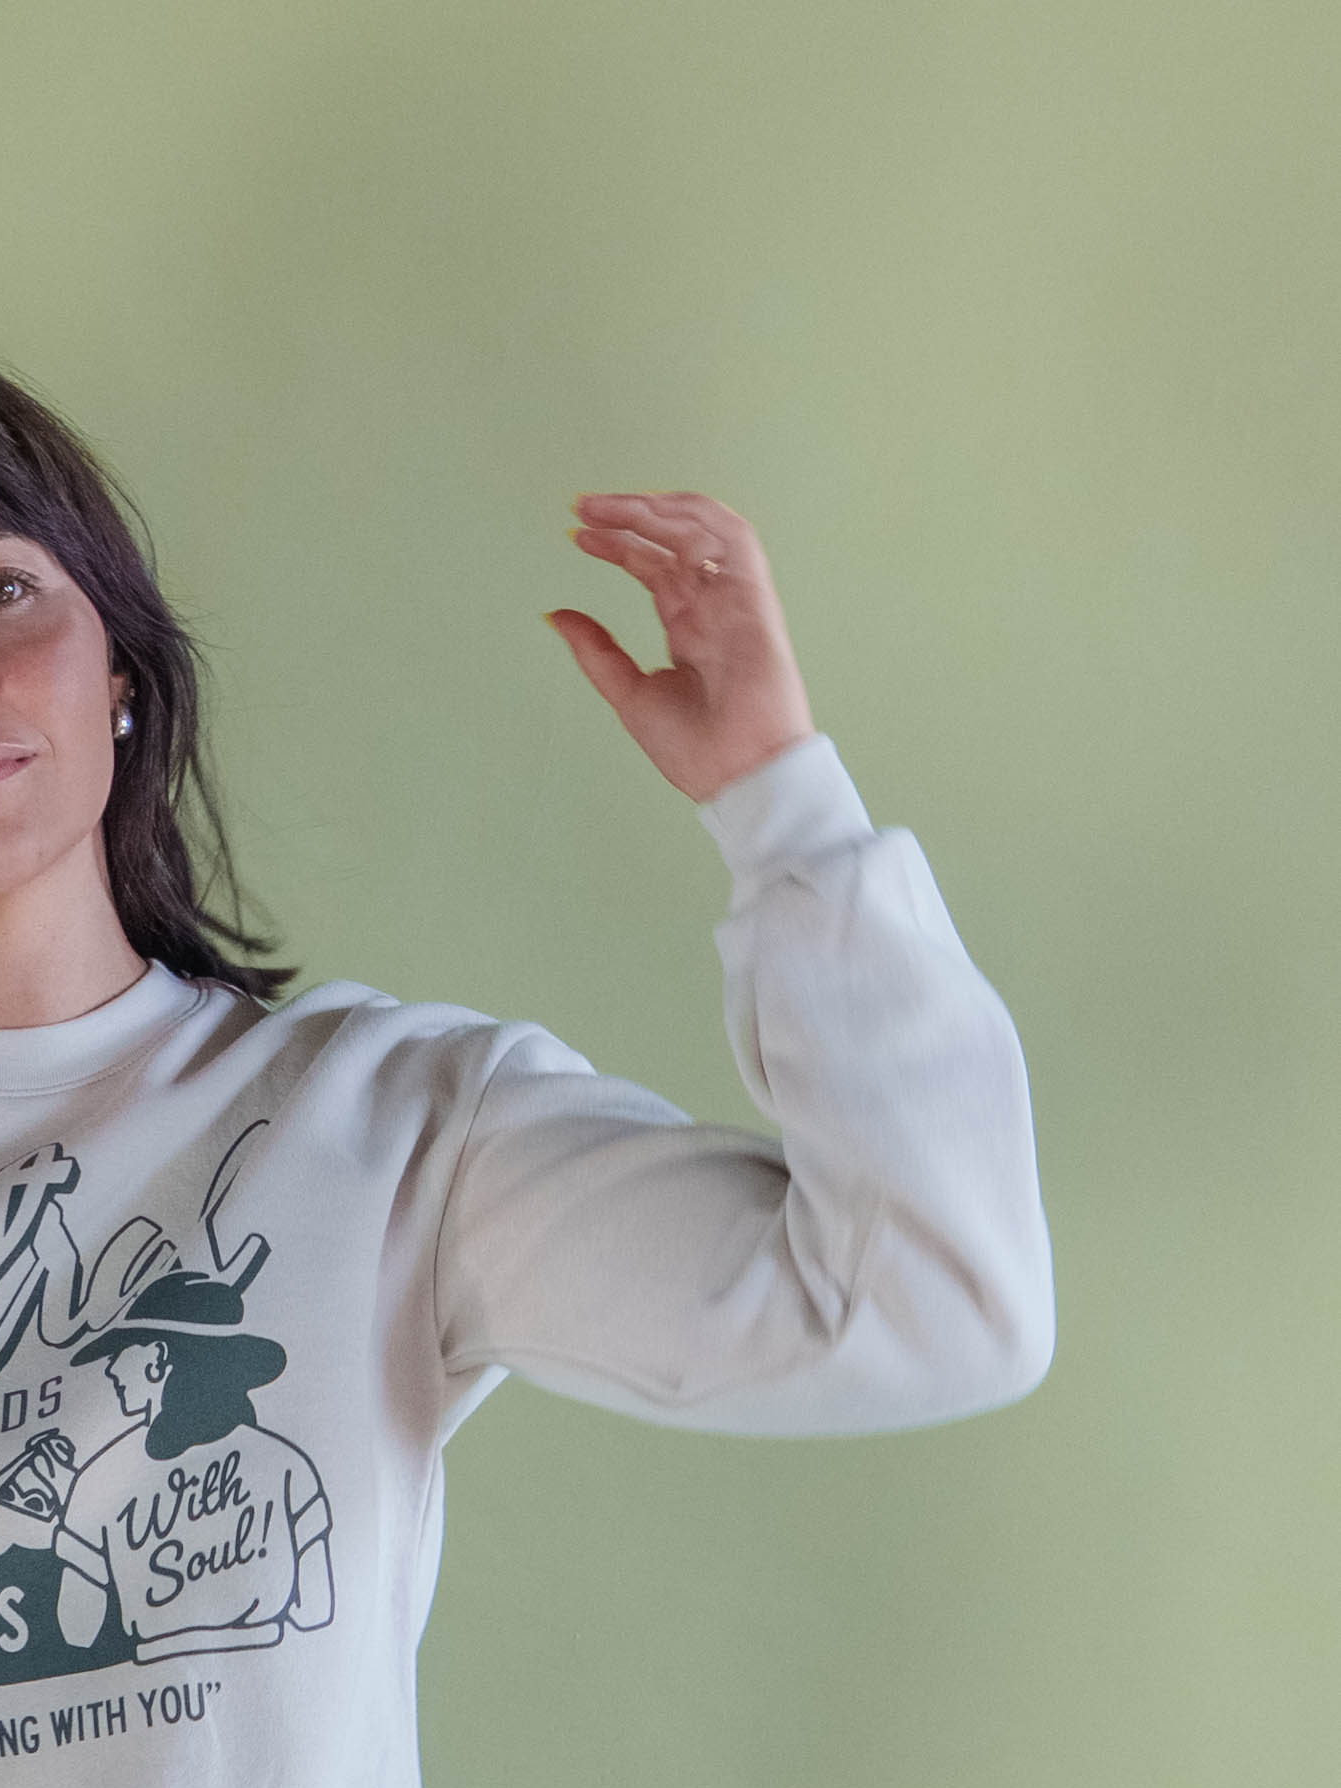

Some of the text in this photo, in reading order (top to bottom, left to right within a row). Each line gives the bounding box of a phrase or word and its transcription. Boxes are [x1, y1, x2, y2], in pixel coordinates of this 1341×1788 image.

[116, 1450, 251, 1551] With
[145, 1500, 274, 1608] Soul!
[49, 1696, 128, 1747] WITH
[137, 1681, 222, 1727] YOU”
